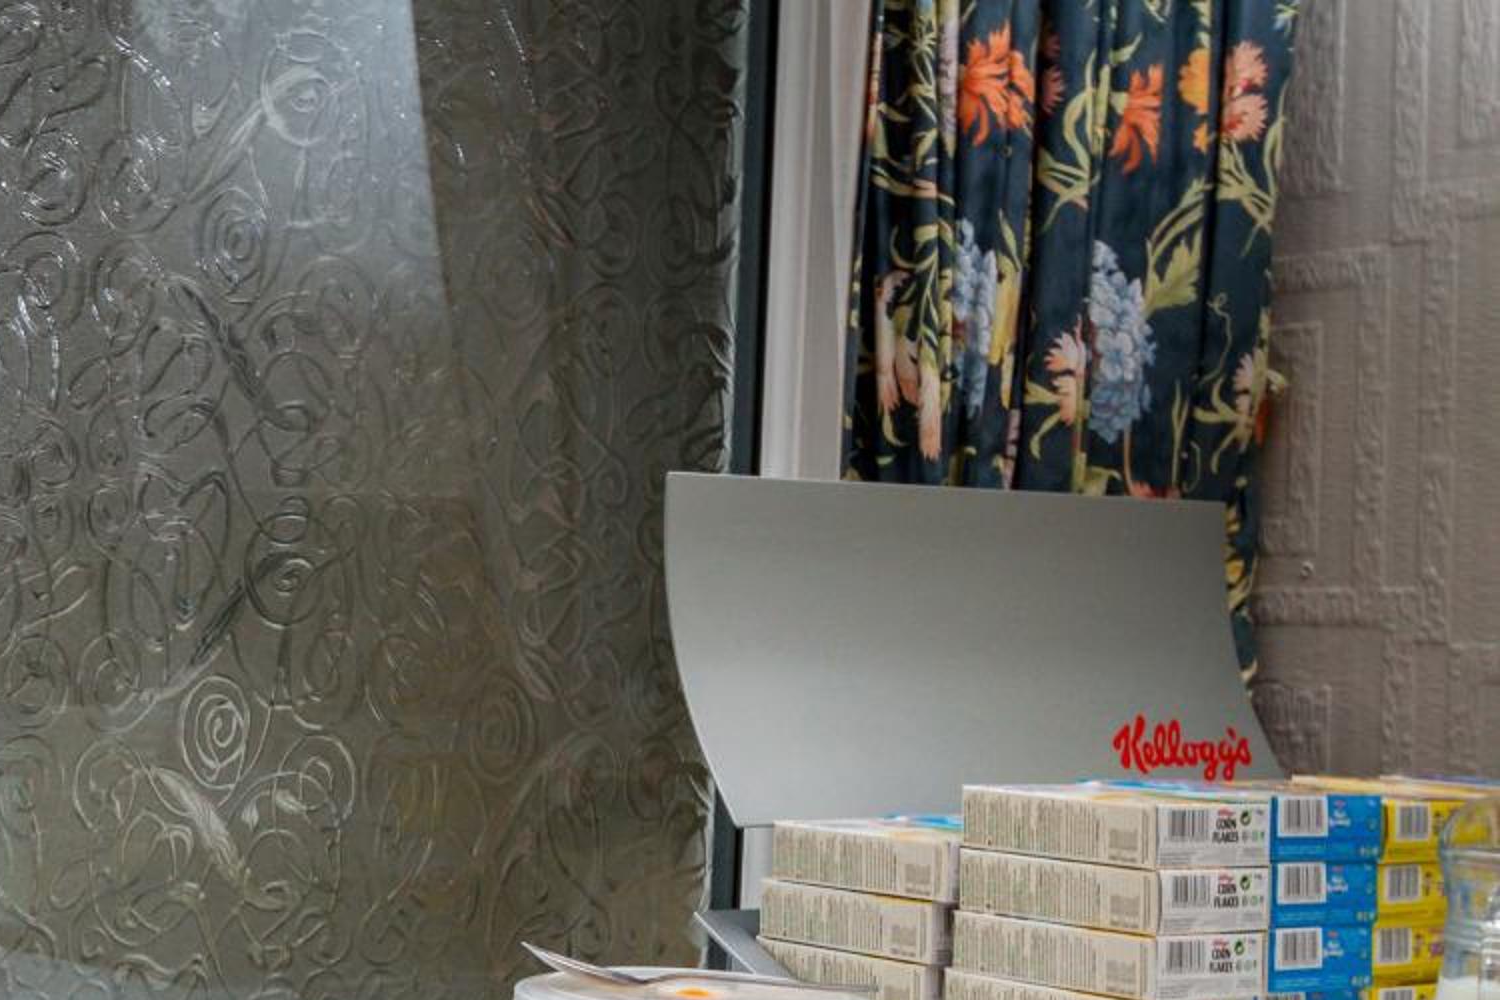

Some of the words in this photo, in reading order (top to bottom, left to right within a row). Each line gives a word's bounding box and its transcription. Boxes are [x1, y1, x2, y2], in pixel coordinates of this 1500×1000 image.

[1113, 713, 1252, 781] Kellogg's
[1216, 818, 1237, 829] CORN
[1212, 831, 1239, 843] FLAKES
[1217, 884, 1237, 895] CORN
[1213, 896, 1239, 908] FLAKES
[1212, 950, 1231, 960] CORN
[1209, 962, 1233, 973] FLAKES
